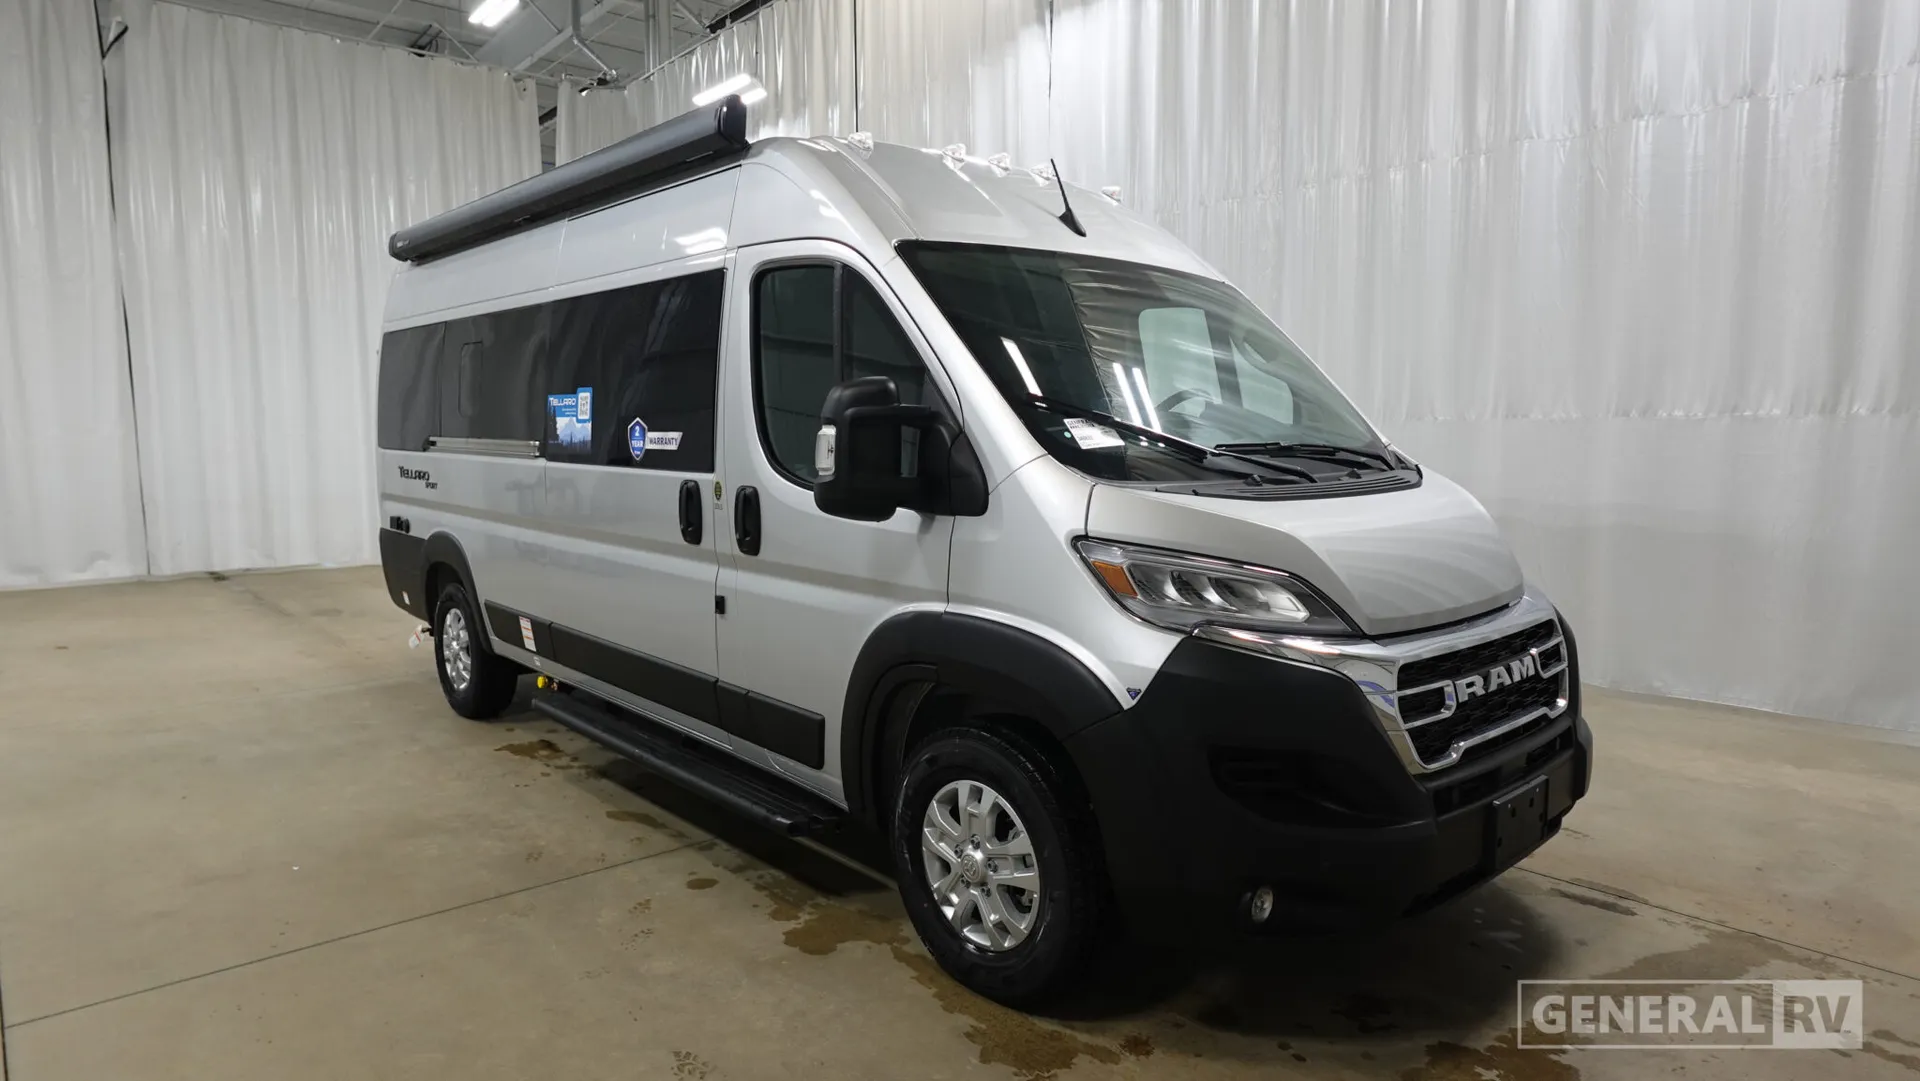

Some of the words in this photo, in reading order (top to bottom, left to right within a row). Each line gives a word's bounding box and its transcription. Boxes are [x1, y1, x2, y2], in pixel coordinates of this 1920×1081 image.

[634, 425, 640, 437] 2
[631, 440, 644, 448] YEAR
[649, 436, 679, 447] WARRANTY
[1454, 655, 1536, 703] RAM
